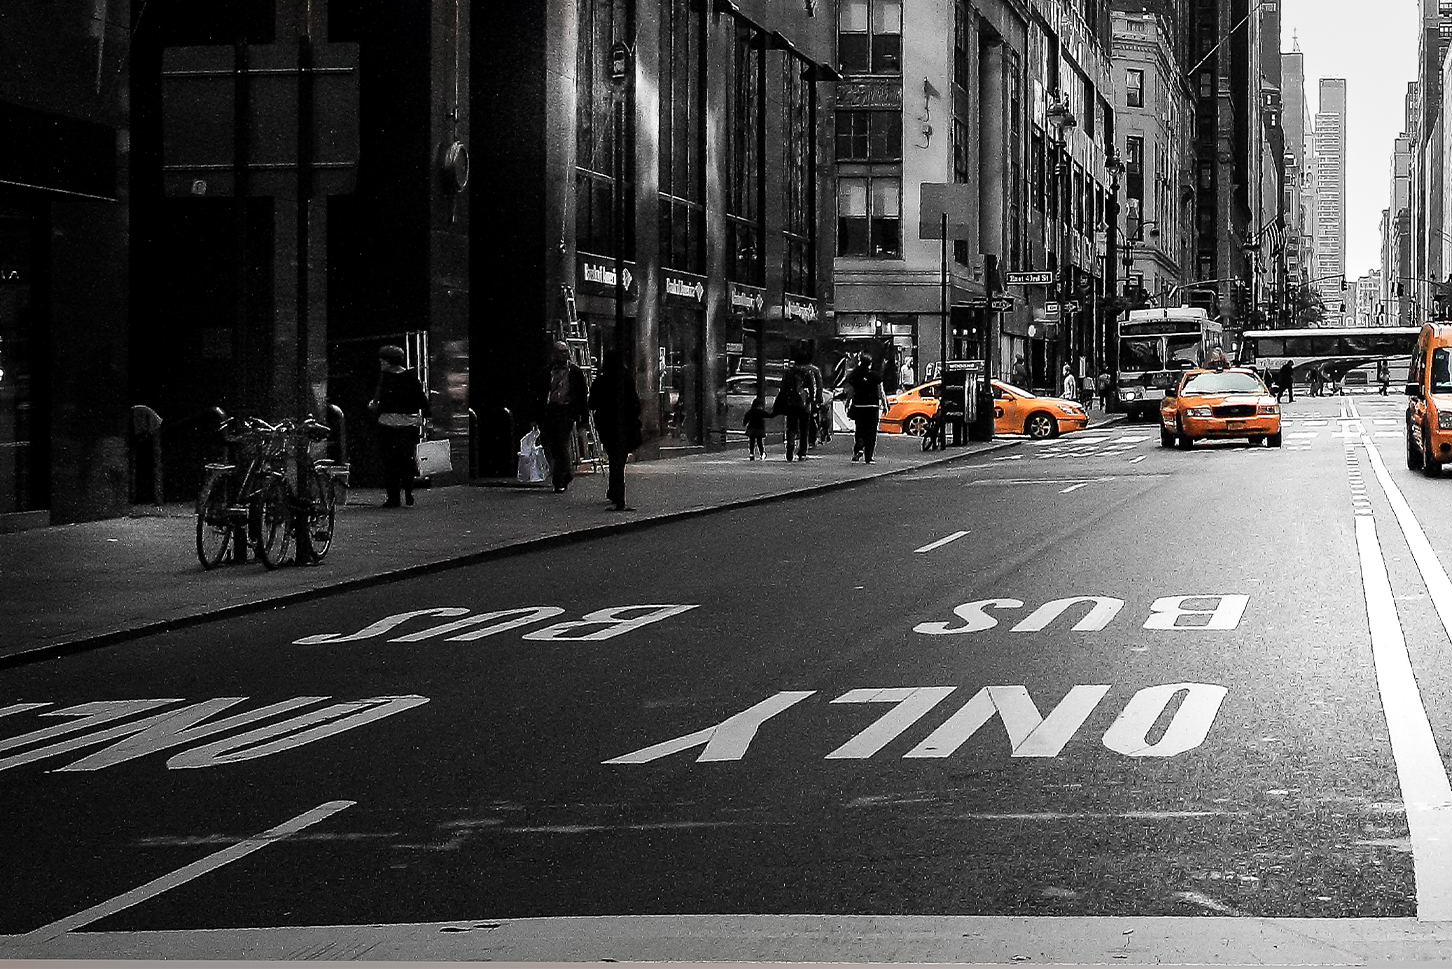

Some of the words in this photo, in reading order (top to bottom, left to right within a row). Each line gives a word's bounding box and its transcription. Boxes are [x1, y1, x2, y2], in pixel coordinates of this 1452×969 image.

[292, 603, 700, 645] BUS
[913, 594, 1250, 635] BUS
[0, 694, 430, 773] ONL
[602, 682, 1228, 765] ONLY
